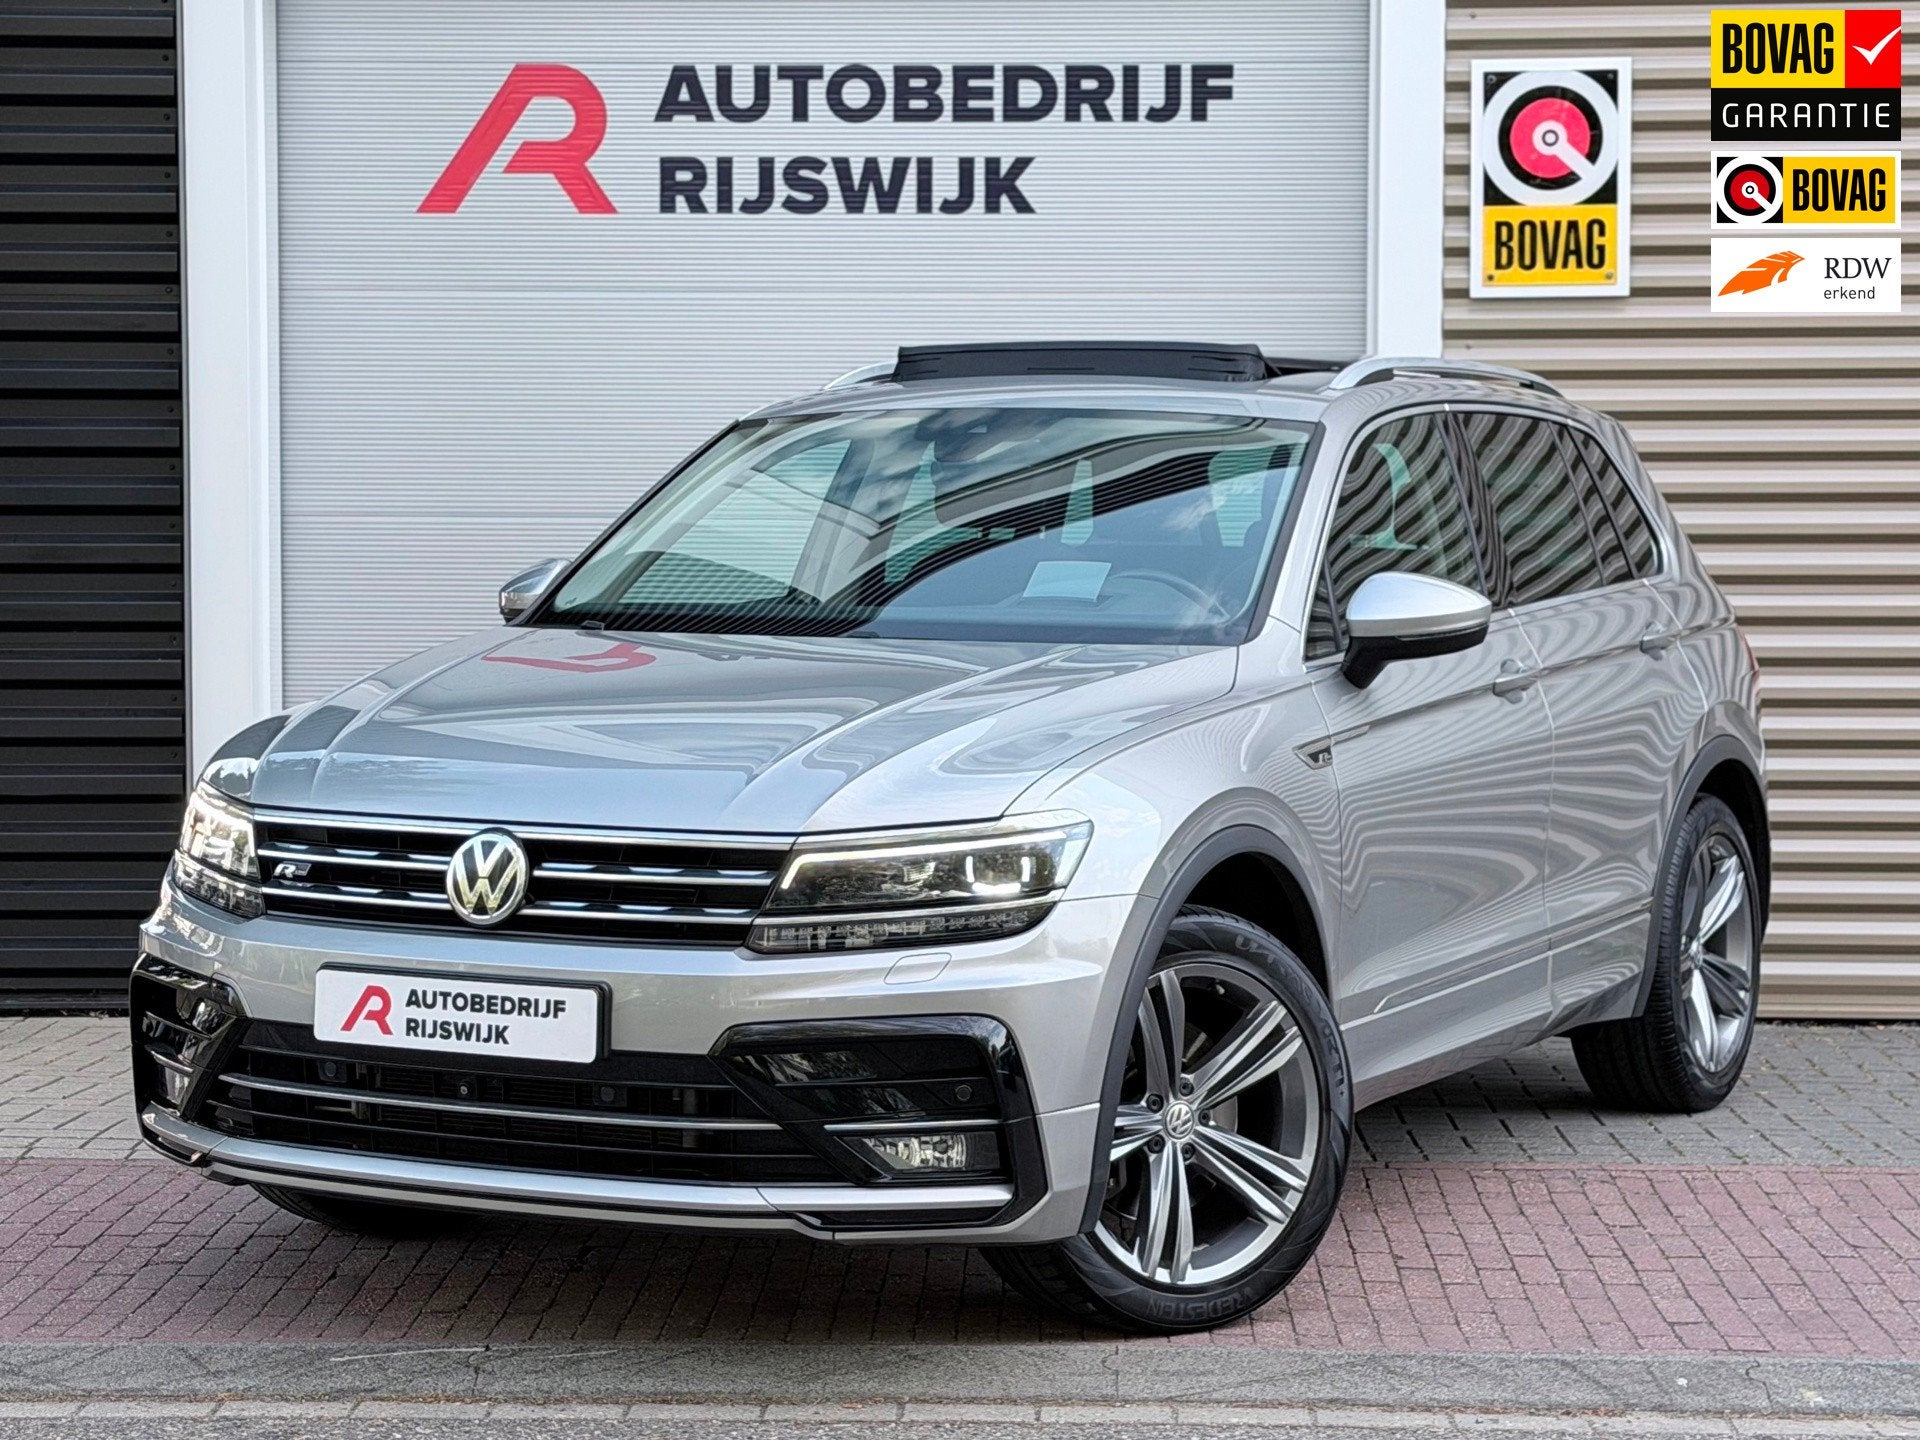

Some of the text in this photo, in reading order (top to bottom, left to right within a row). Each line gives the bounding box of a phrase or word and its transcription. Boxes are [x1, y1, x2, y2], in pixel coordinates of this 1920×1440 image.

[655, 64, 1235, 123] AUTOBEDRIJF
[659, 157, 1037, 215] RIJSWIJK
[1494, 218, 1607, 272] BOVAG
[405, 988, 567, 1019] AUTOBEDRIJF
[405, 1017, 510, 1045] RIJSWIJK
